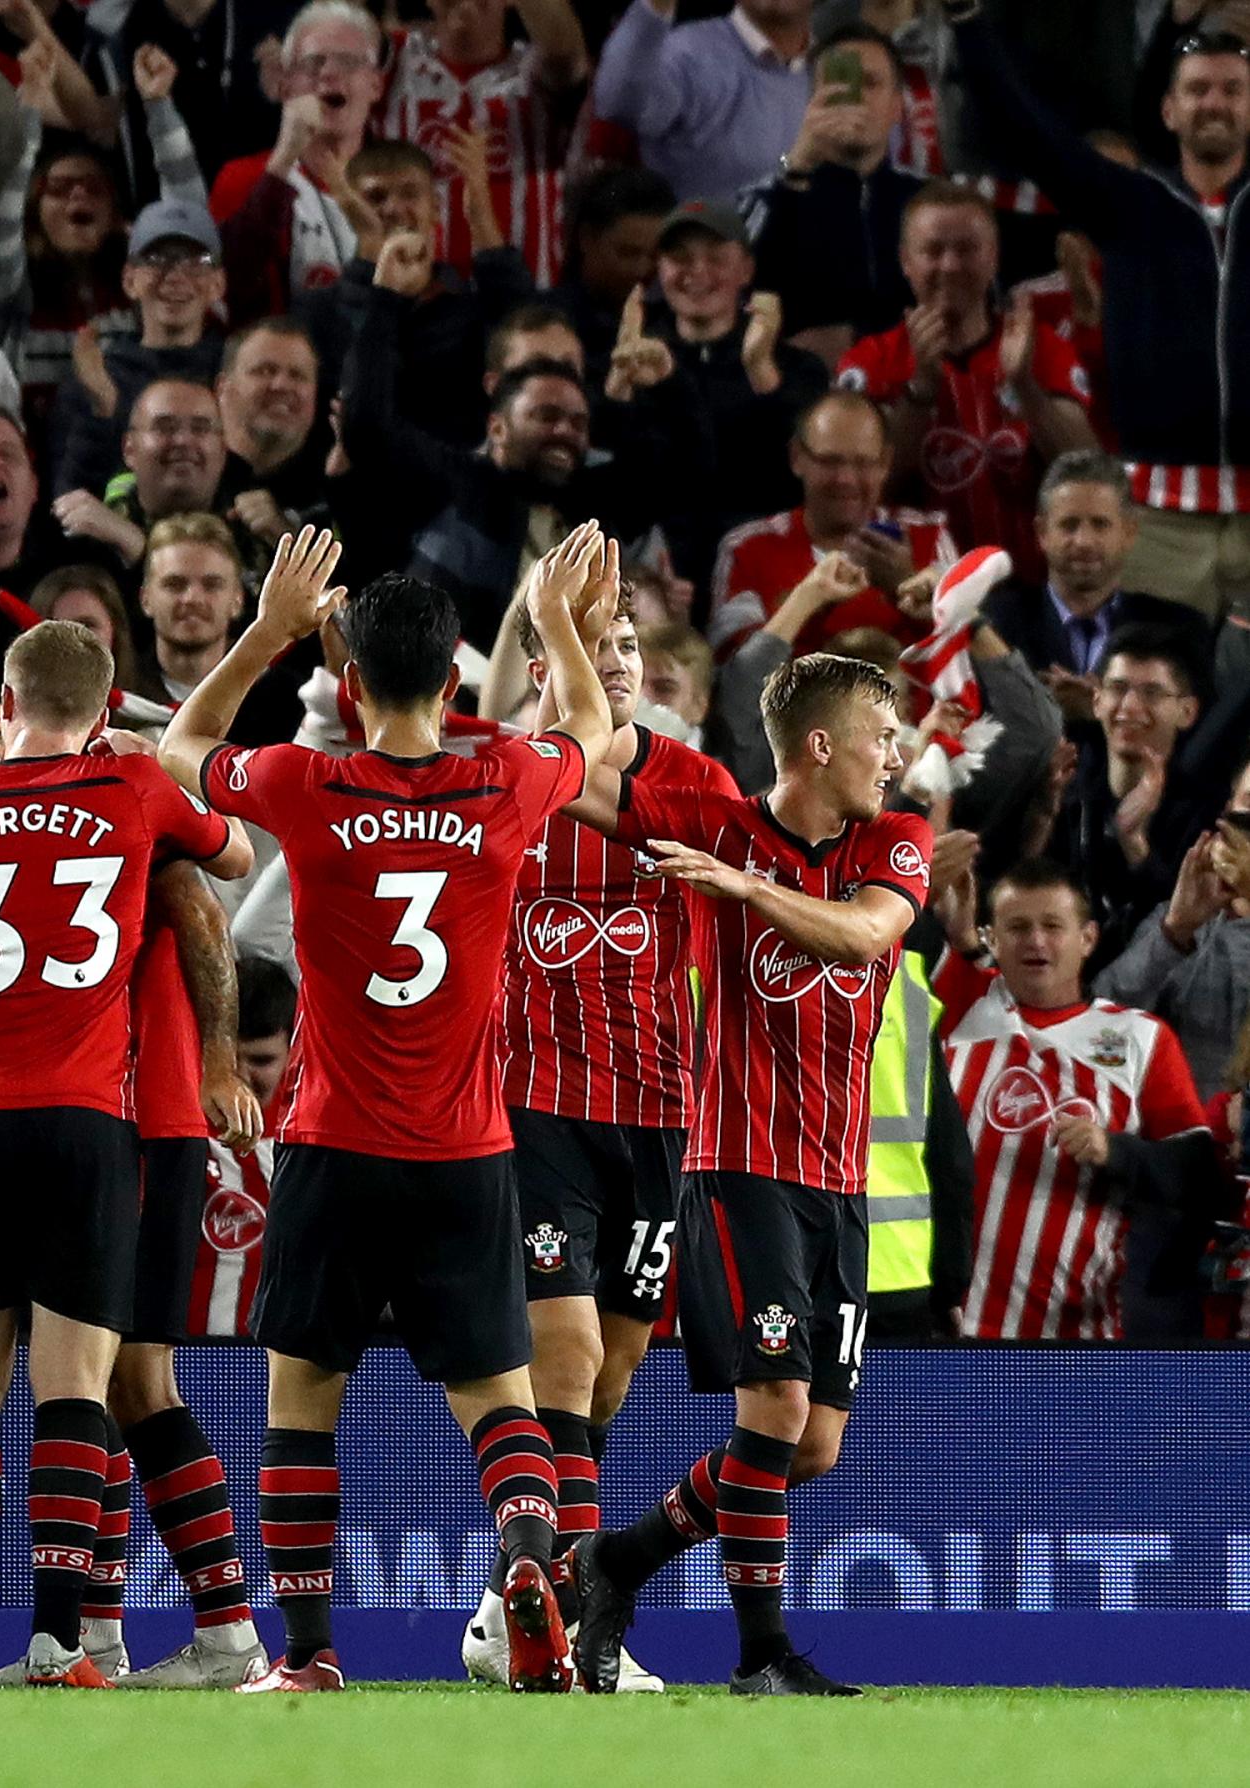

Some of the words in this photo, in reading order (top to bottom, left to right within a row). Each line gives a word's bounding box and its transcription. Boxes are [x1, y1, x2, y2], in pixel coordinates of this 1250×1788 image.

[330, 809, 483, 856] YOSHIDA
[365, 872, 448, 1007] 3
[533, 907, 587, 955] Virgin
[609, 922, 645, 936] media
[759, 941, 812, 990] Virgin
[623, 1220, 677, 1279] 15
